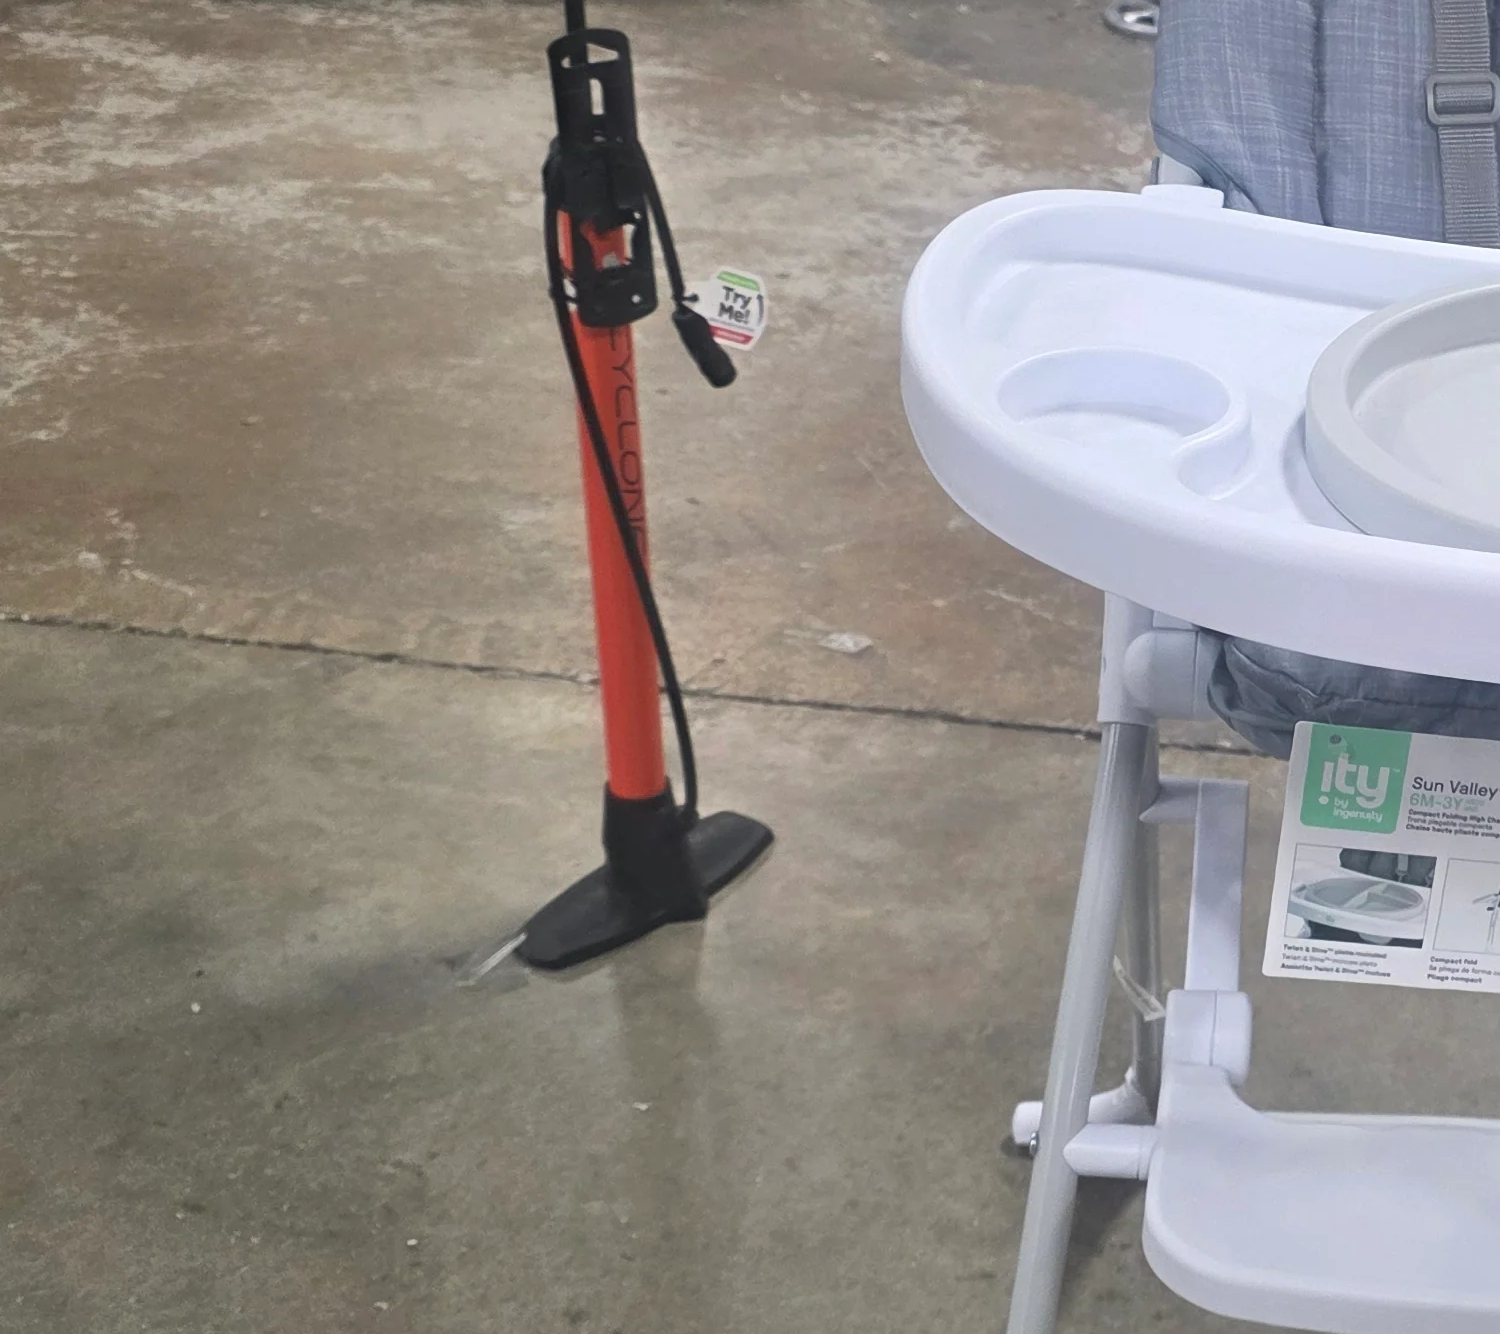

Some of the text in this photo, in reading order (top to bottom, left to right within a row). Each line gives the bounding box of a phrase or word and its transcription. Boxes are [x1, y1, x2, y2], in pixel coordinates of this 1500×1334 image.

[722, 285, 752, 309] Try
[718, 302, 751, 325] Me!
[1412, 776, 1444, 793] Sun
[1334, 797, 1349, 810] by
[1409, 793, 1463, 811] 6M-3Y
[1333, 806, 1383, 823] ingenuity
